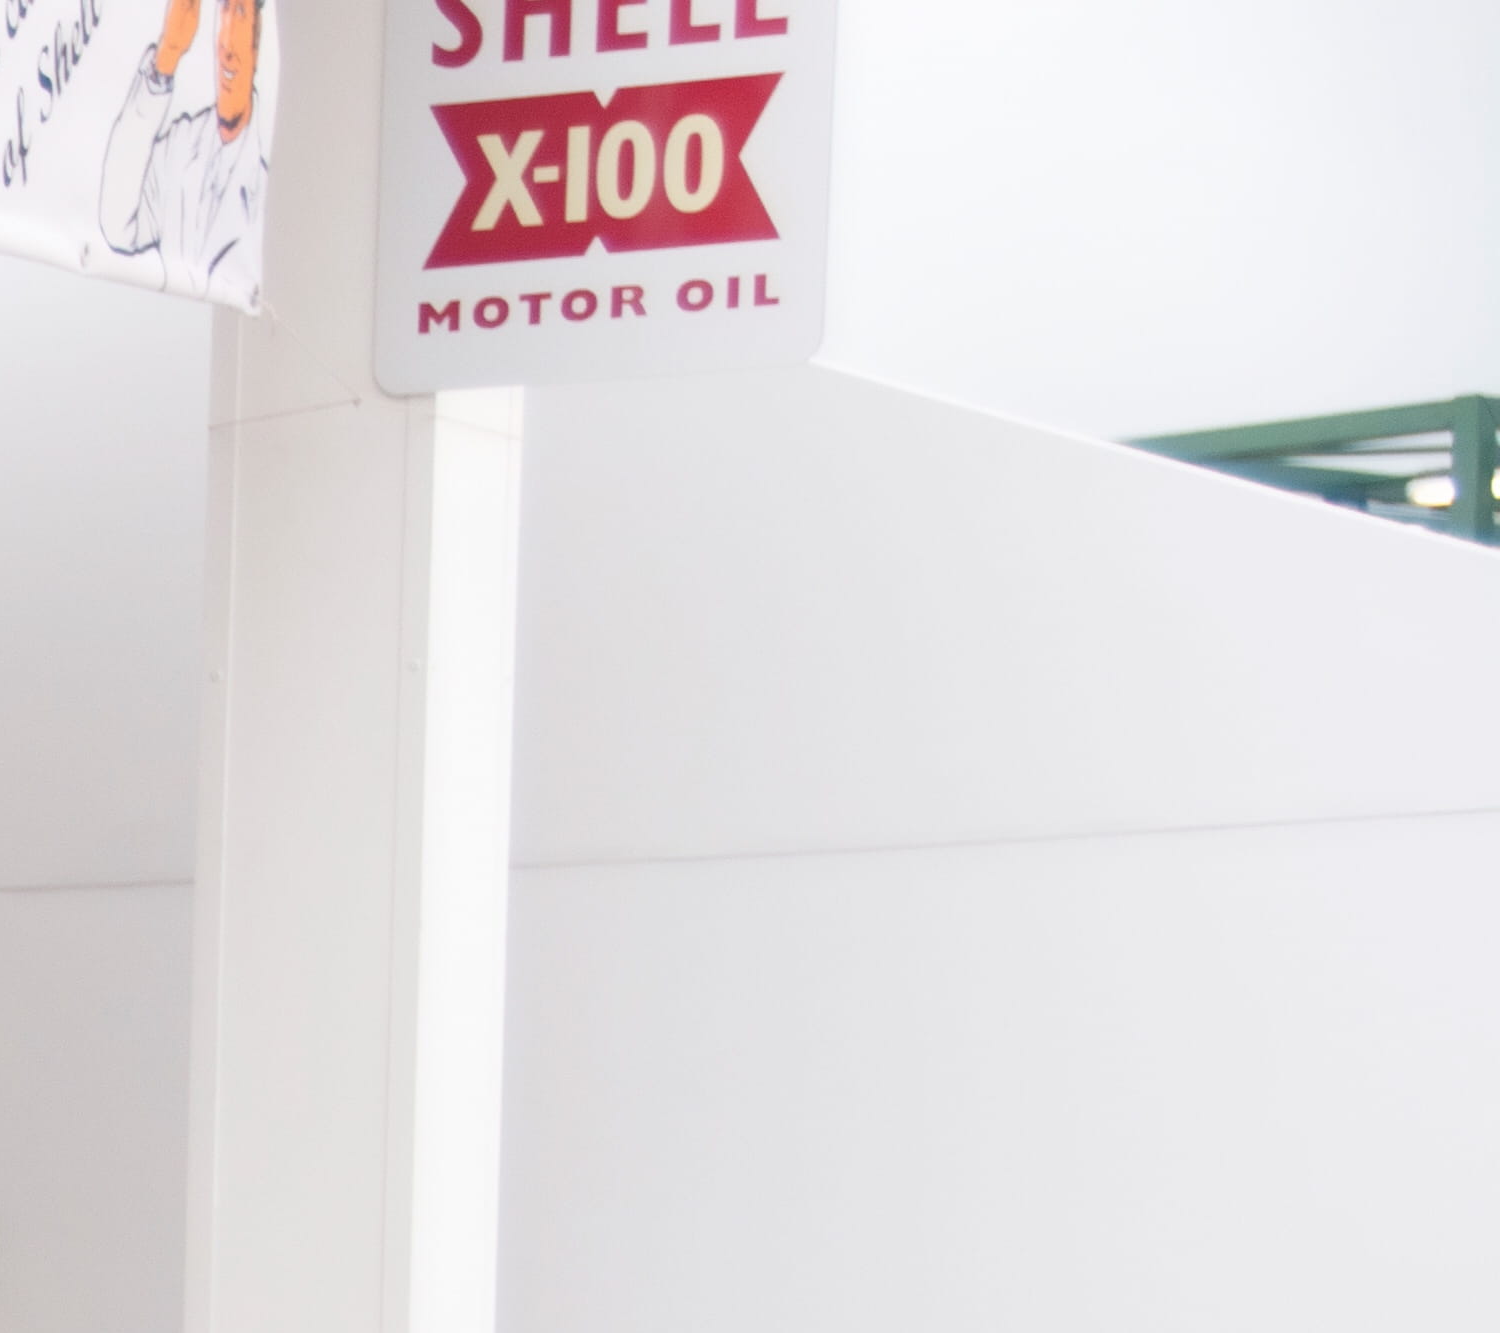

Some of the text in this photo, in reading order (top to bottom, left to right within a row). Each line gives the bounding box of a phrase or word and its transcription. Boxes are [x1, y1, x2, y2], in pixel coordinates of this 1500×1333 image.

[3, 86, 32, 187] of
[470, 113, 724, 232] X-100
[417, 273, 780, 334] MOTOR OIL
